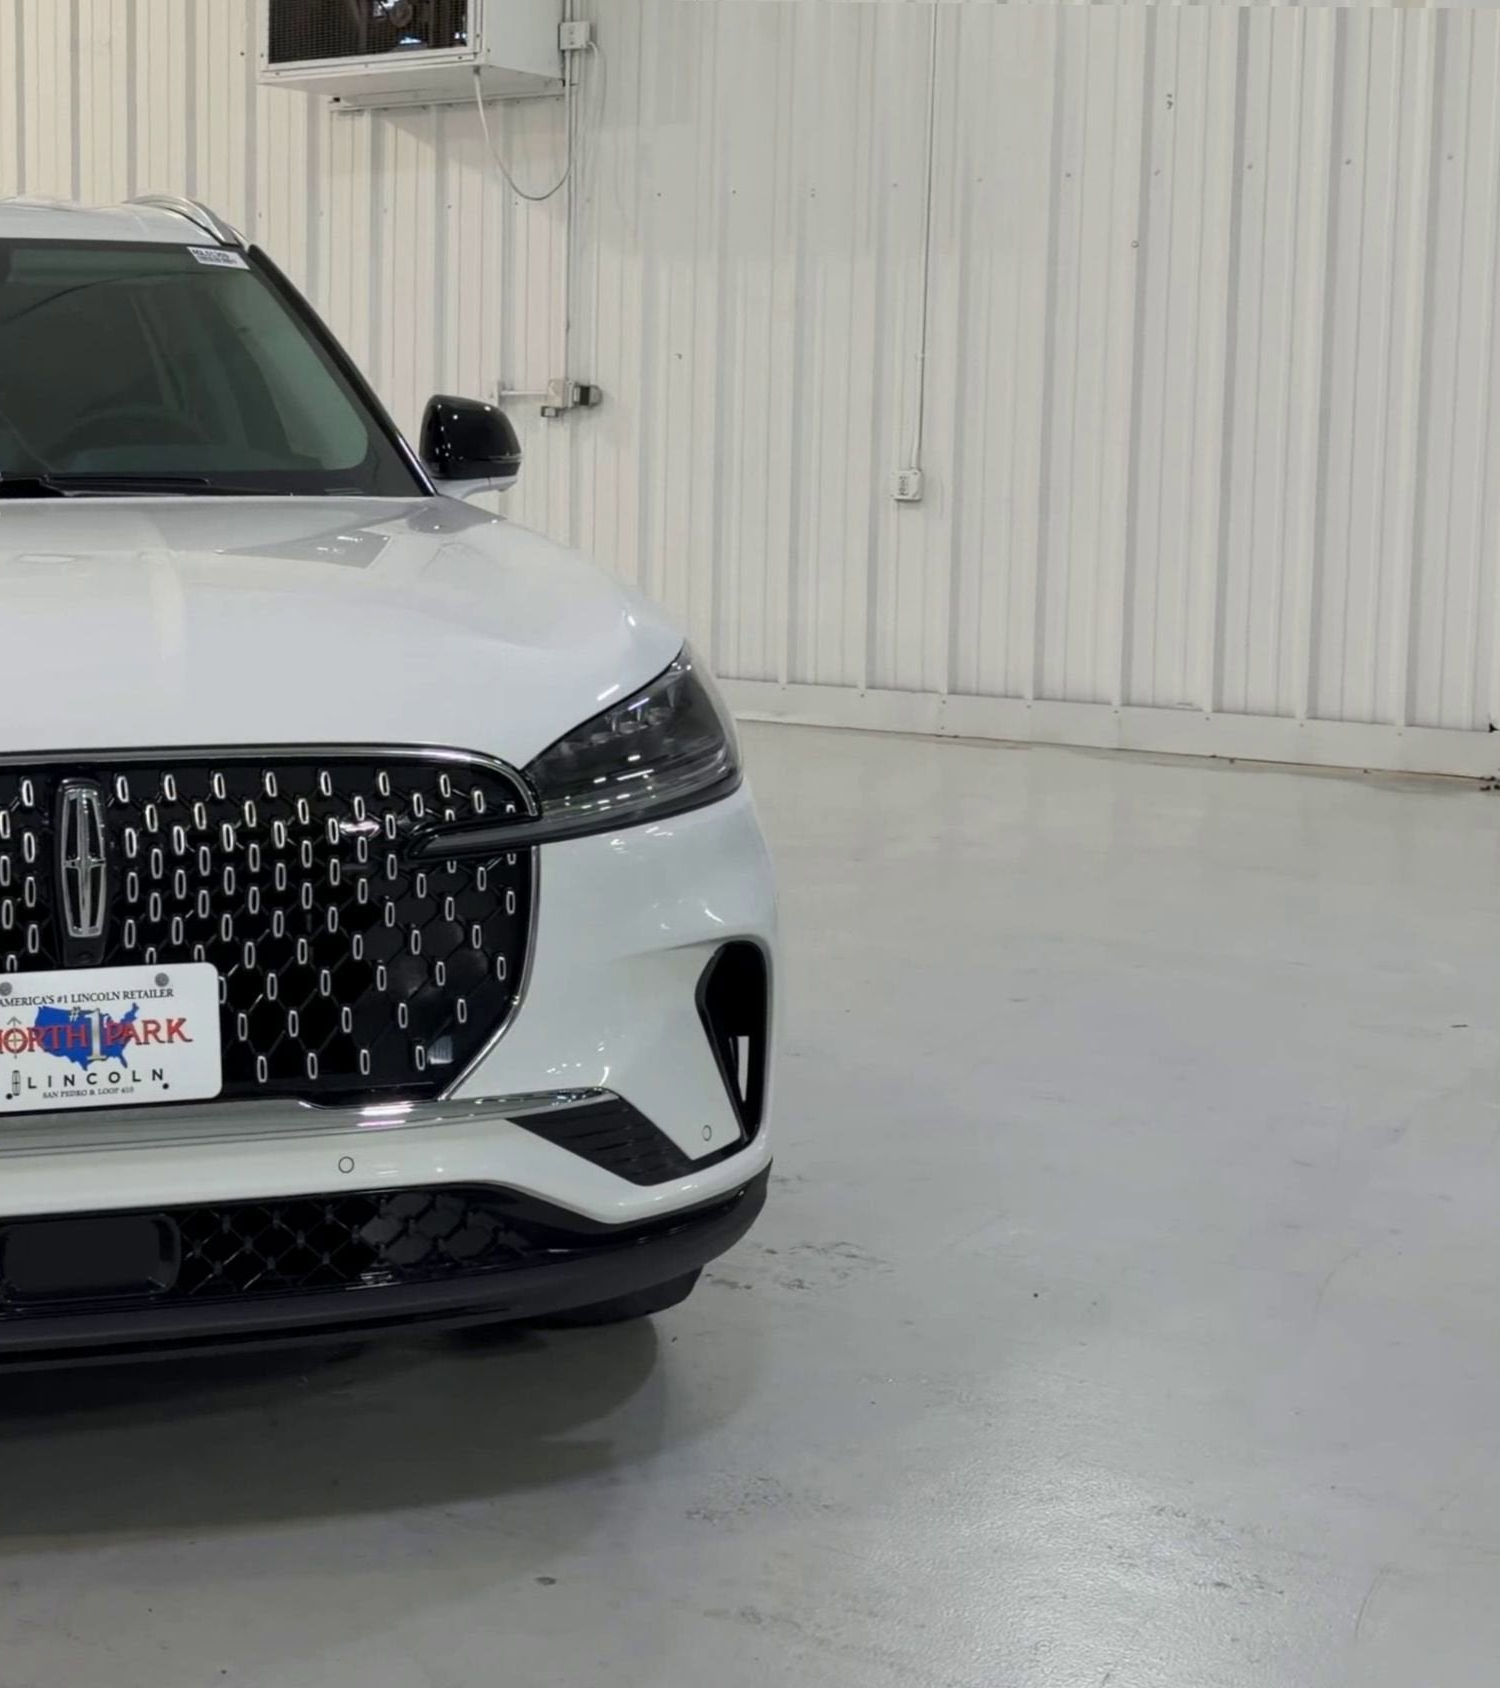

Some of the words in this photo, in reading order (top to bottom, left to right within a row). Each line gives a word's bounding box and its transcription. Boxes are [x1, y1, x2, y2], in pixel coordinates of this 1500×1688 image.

[57, 994, 68, 1004] #1
[71, 990, 121, 1003] LINCOLN
[122, 988, 174, 1001] RETAILER
[106, 1017, 194, 1048] PARK
[27, 1067, 165, 1090] LINCOLN
[42, 1090, 59, 1099] SAN
[60, 1089, 88, 1099] PEDRO
[98, 1087, 120, 1096] LOOP
